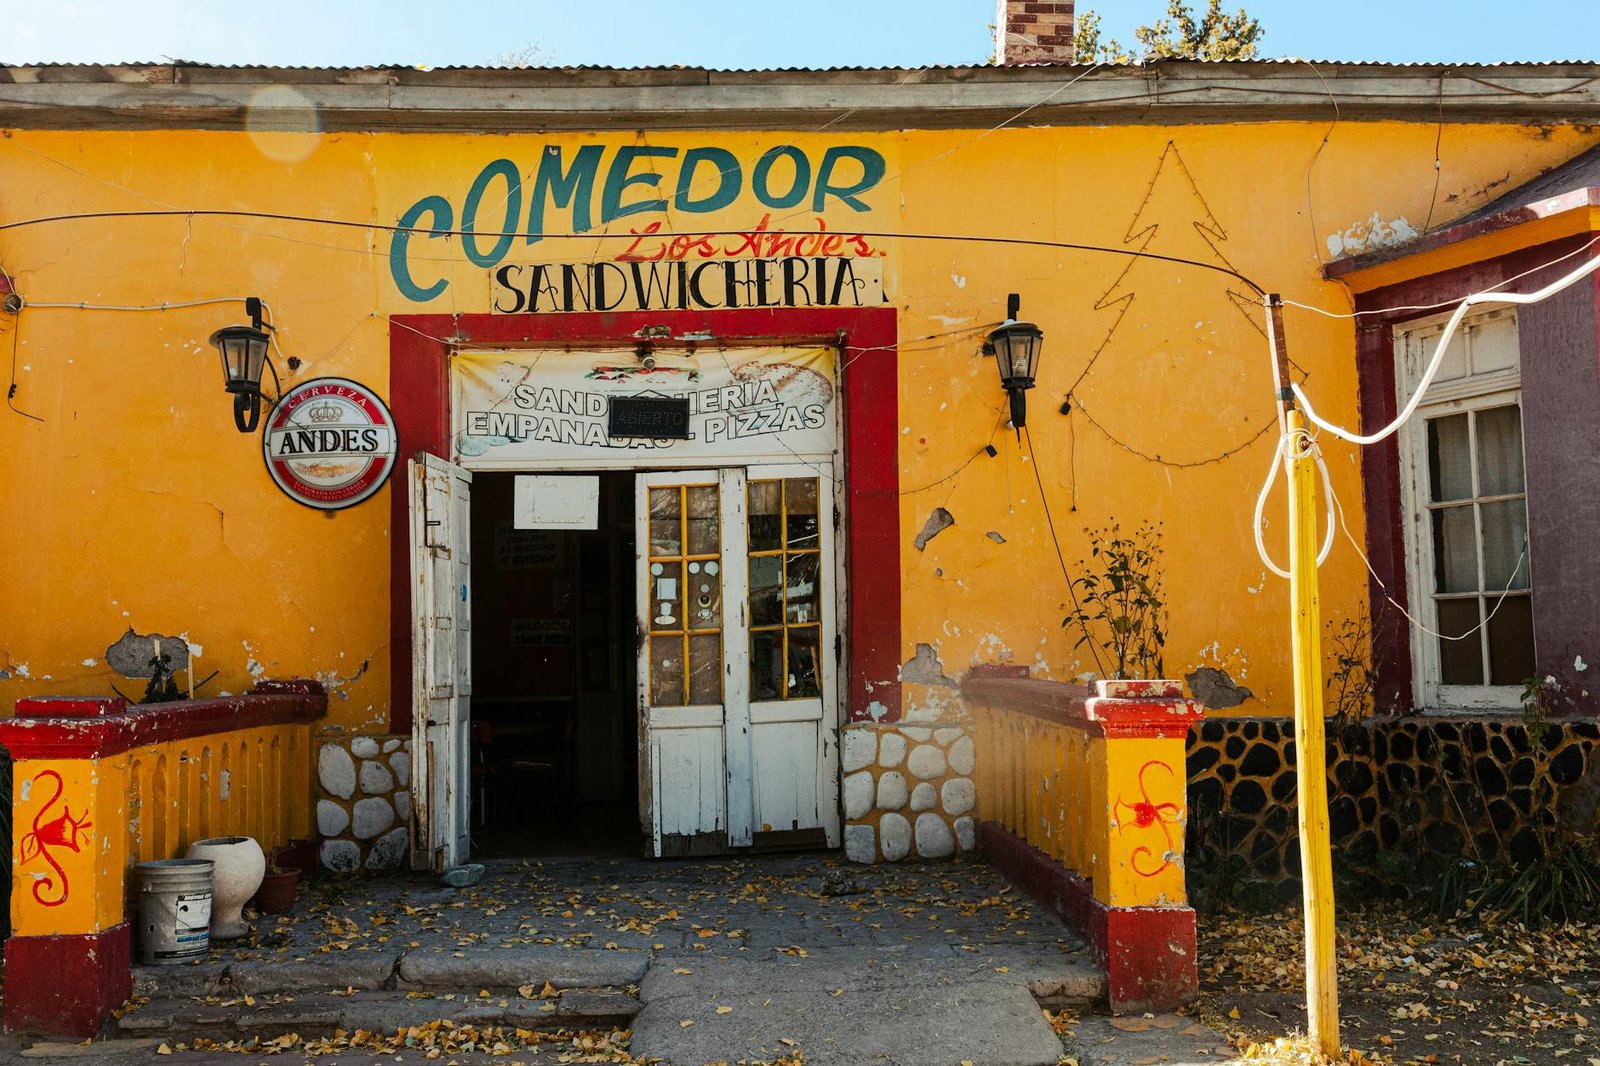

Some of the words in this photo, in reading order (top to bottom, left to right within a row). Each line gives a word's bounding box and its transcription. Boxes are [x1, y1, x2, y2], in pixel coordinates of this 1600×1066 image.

[390, 145, 886, 302] COMEDOR
[615, 221, 719, 261] Los
[494, 256, 866, 313] SANDWICHERIA
[288, 386, 367, 409] CERVEZA
[514, 379, 780, 416] SANDHERIA
[615, 409, 684, 426] ABIERTO
[705, 404, 826, 443] PIZZAS
[279, 429, 379, 454] ANDES
